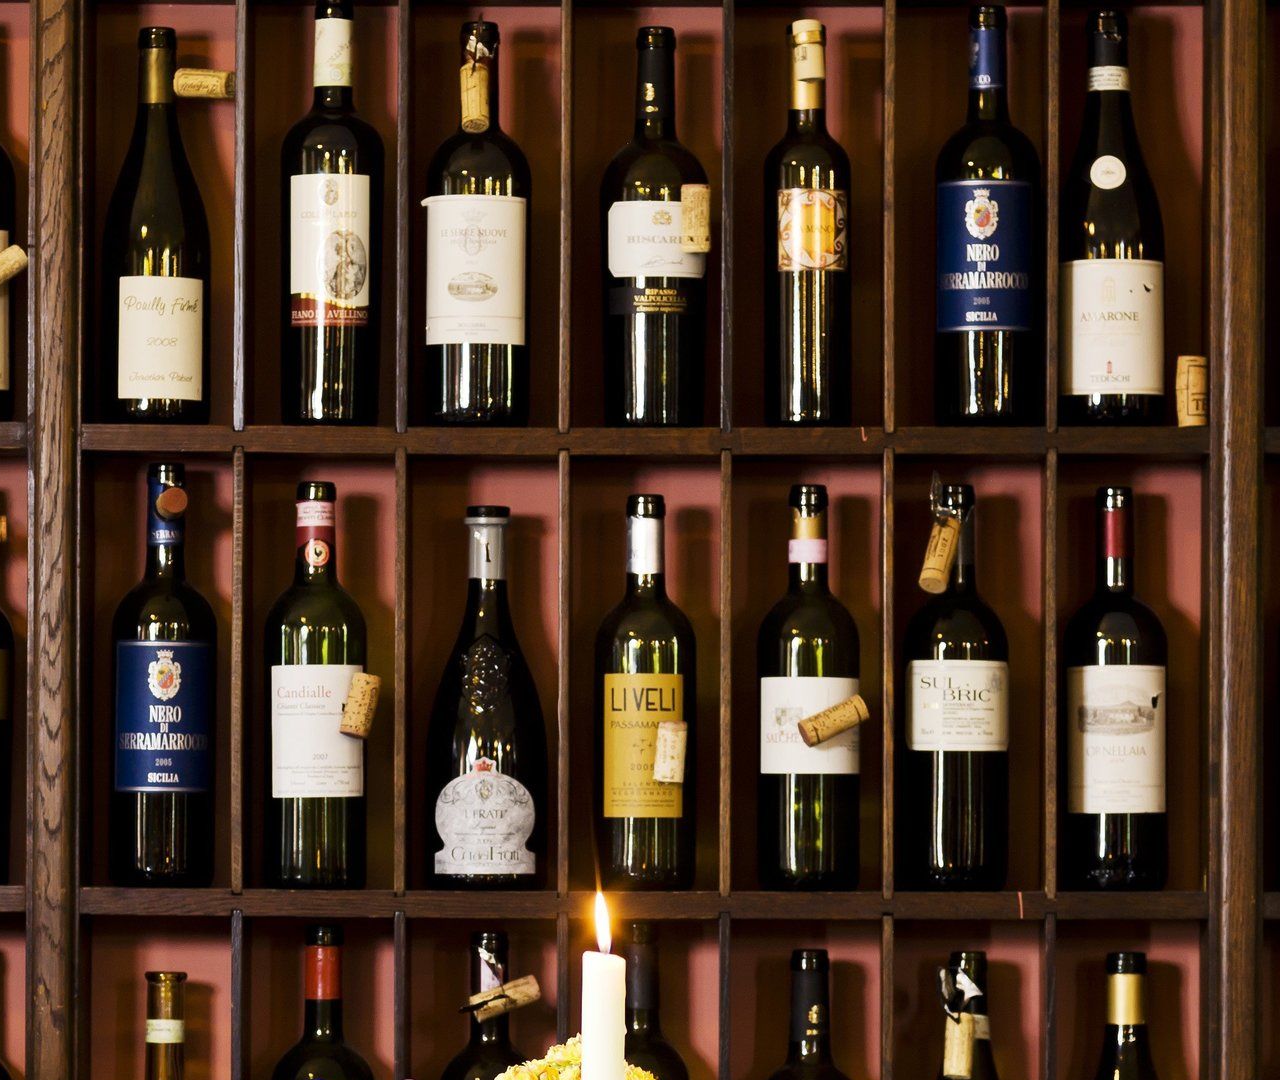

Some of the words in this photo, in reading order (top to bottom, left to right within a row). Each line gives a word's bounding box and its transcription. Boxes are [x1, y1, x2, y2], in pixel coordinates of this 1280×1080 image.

[626, 235, 682, 244] BISCAR
[966, 243, 1000, 262] NERO
[977, 262, 986, 271] DI
[124, 294, 167, 315] Pouilly
[326, 310, 368, 320] AVELLINO
[965, 311, 998, 323] SICILIA
[147, 336, 178, 347] 2008
[919, 676, 954, 690] SUL
[276, 686, 332, 700] Candialle
[611, 687, 628, 712] LI
[631, 687, 676, 711] VELI
[942, 686, 992, 703] BRIC
[149, 705, 182, 723] NERO
[159, 723, 169, 733] DI
[147, 772, 179, 783] SICILIA
